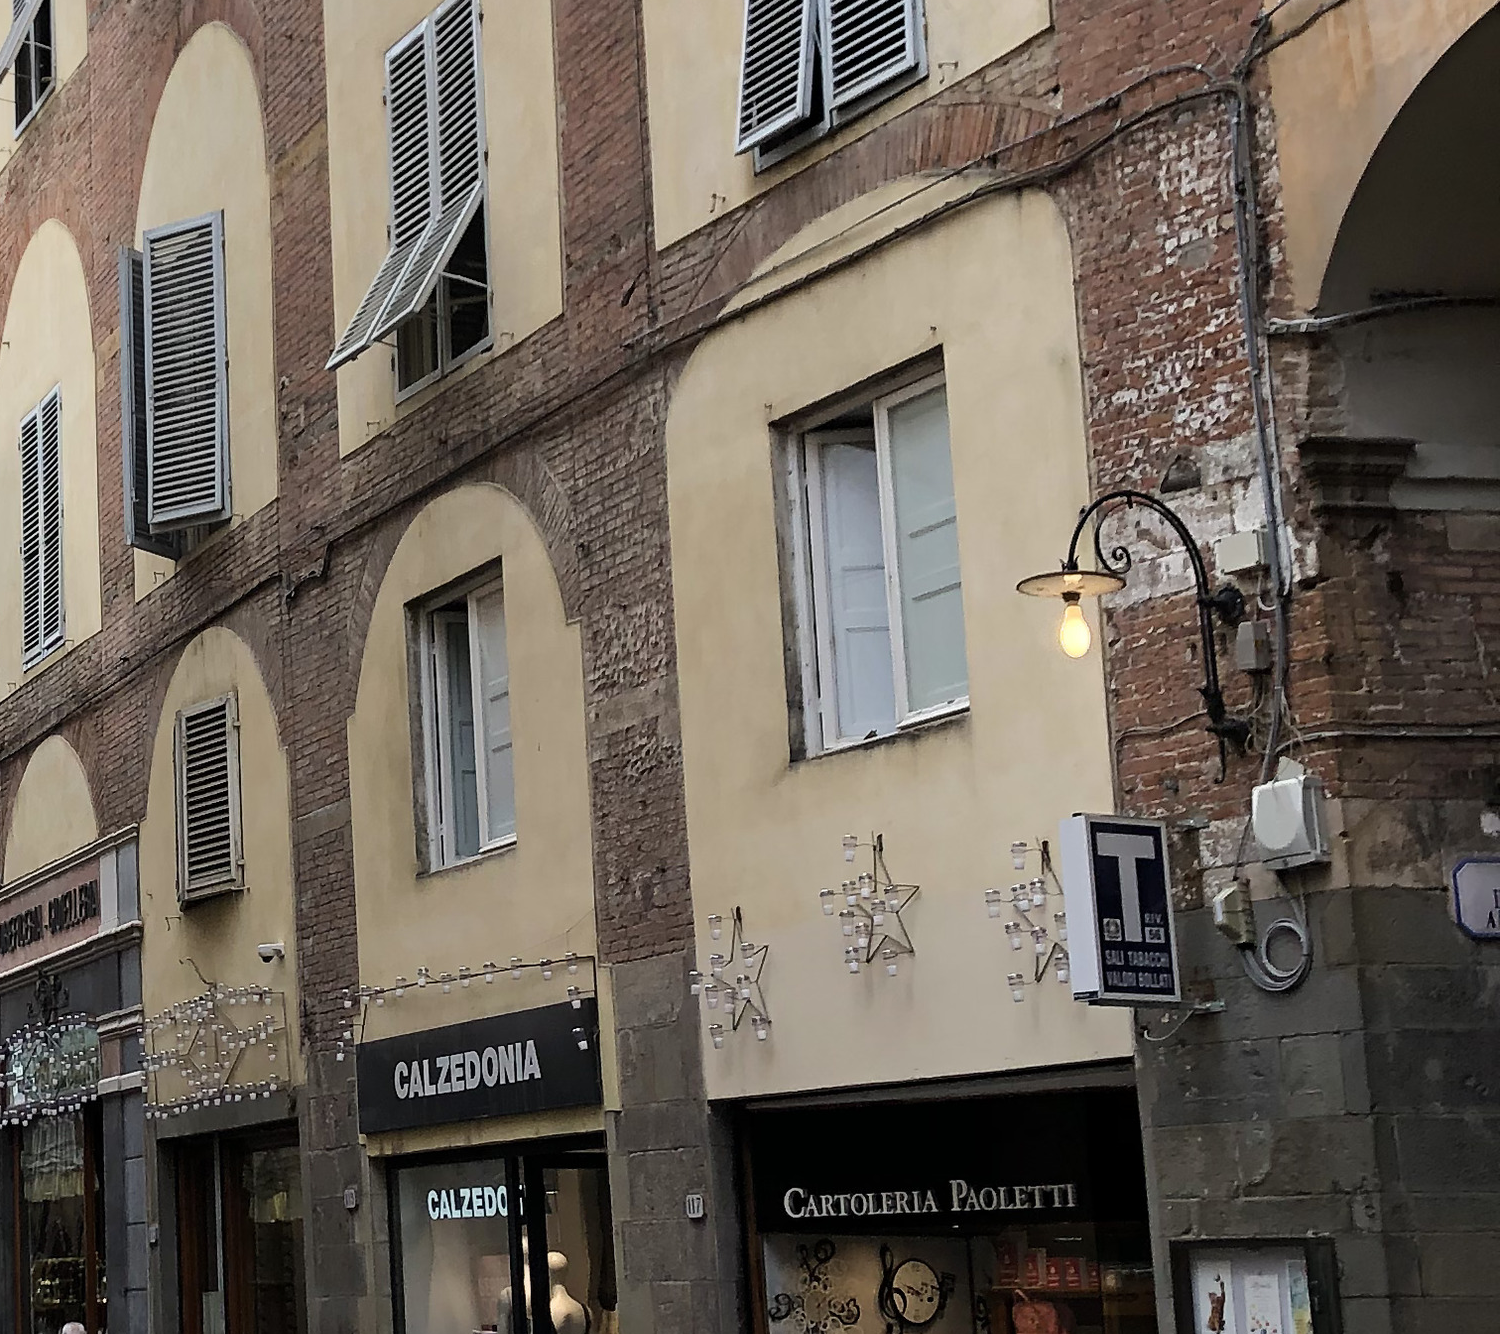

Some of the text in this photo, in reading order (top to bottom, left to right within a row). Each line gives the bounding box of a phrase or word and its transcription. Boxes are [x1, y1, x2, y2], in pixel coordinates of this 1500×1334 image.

[1097, 832, 1155, 942] T
[394, 1039, 542, 1099] CALZEDONIA
[427, 1185, 510, 1220] CALZEDO
[783, 1179, 1080, 1218] CARTOLERIA PAOLETTI
